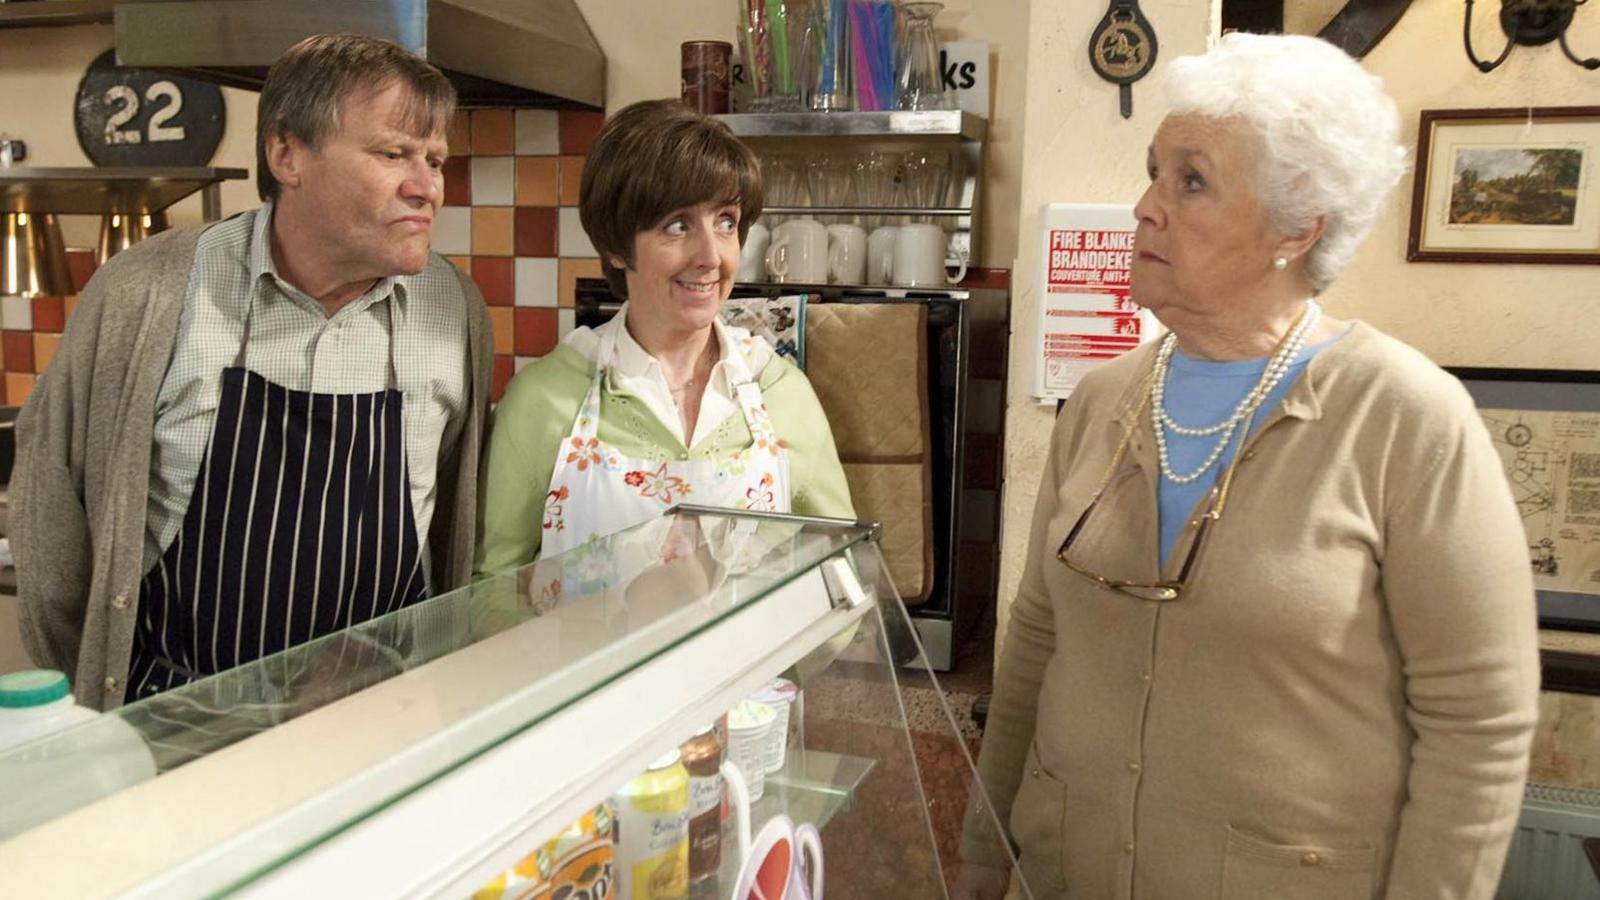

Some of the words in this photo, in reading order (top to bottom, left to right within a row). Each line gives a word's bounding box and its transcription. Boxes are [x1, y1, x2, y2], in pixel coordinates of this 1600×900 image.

[940, 49, 976, 92] ks
[104, 80, 186, 145] 22
[1052, 231, 1083, 250] FIRE
[1084, 231, 1136, 250] BLANKE
[1051, 250, 1132, 269] BRANDDEKE
[1103, 270, 1130, 282] ANTI-F
